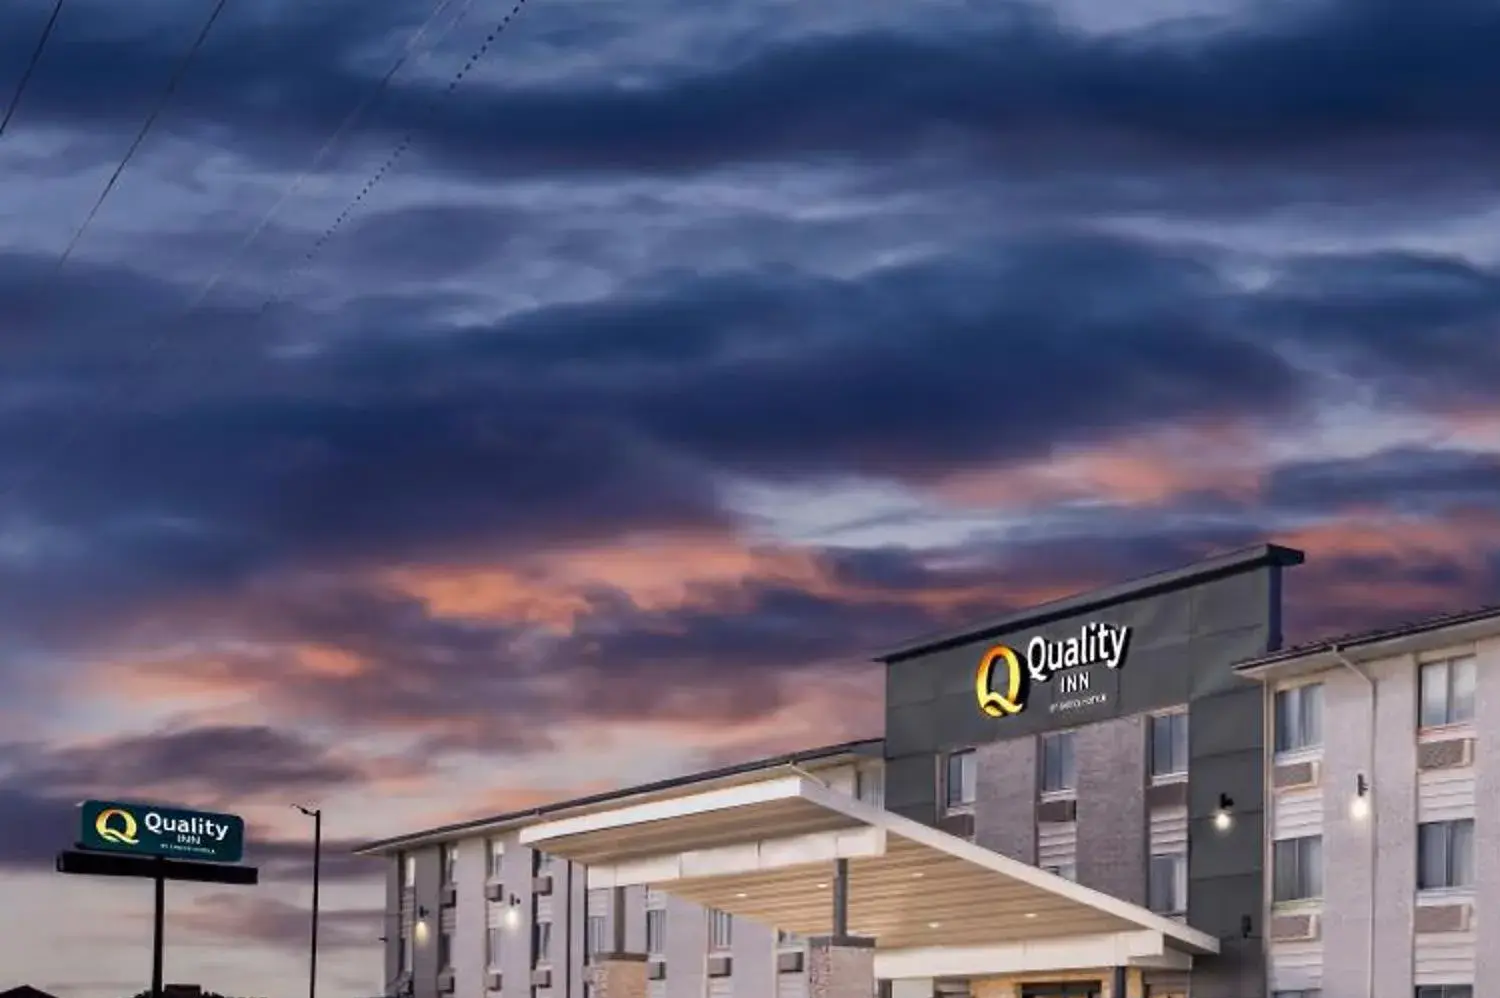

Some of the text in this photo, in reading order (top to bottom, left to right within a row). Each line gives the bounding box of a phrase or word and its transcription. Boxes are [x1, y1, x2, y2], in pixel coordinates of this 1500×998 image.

[1027, 622, 1127, 681] Quality
[976, 644, 1023, 717] Q
[1060, 671, 1090, 693] INN
[95, 808, 139, 844] Q
[144, 812, 229, 841] Quality
[177, 834, 201, 845] INN
